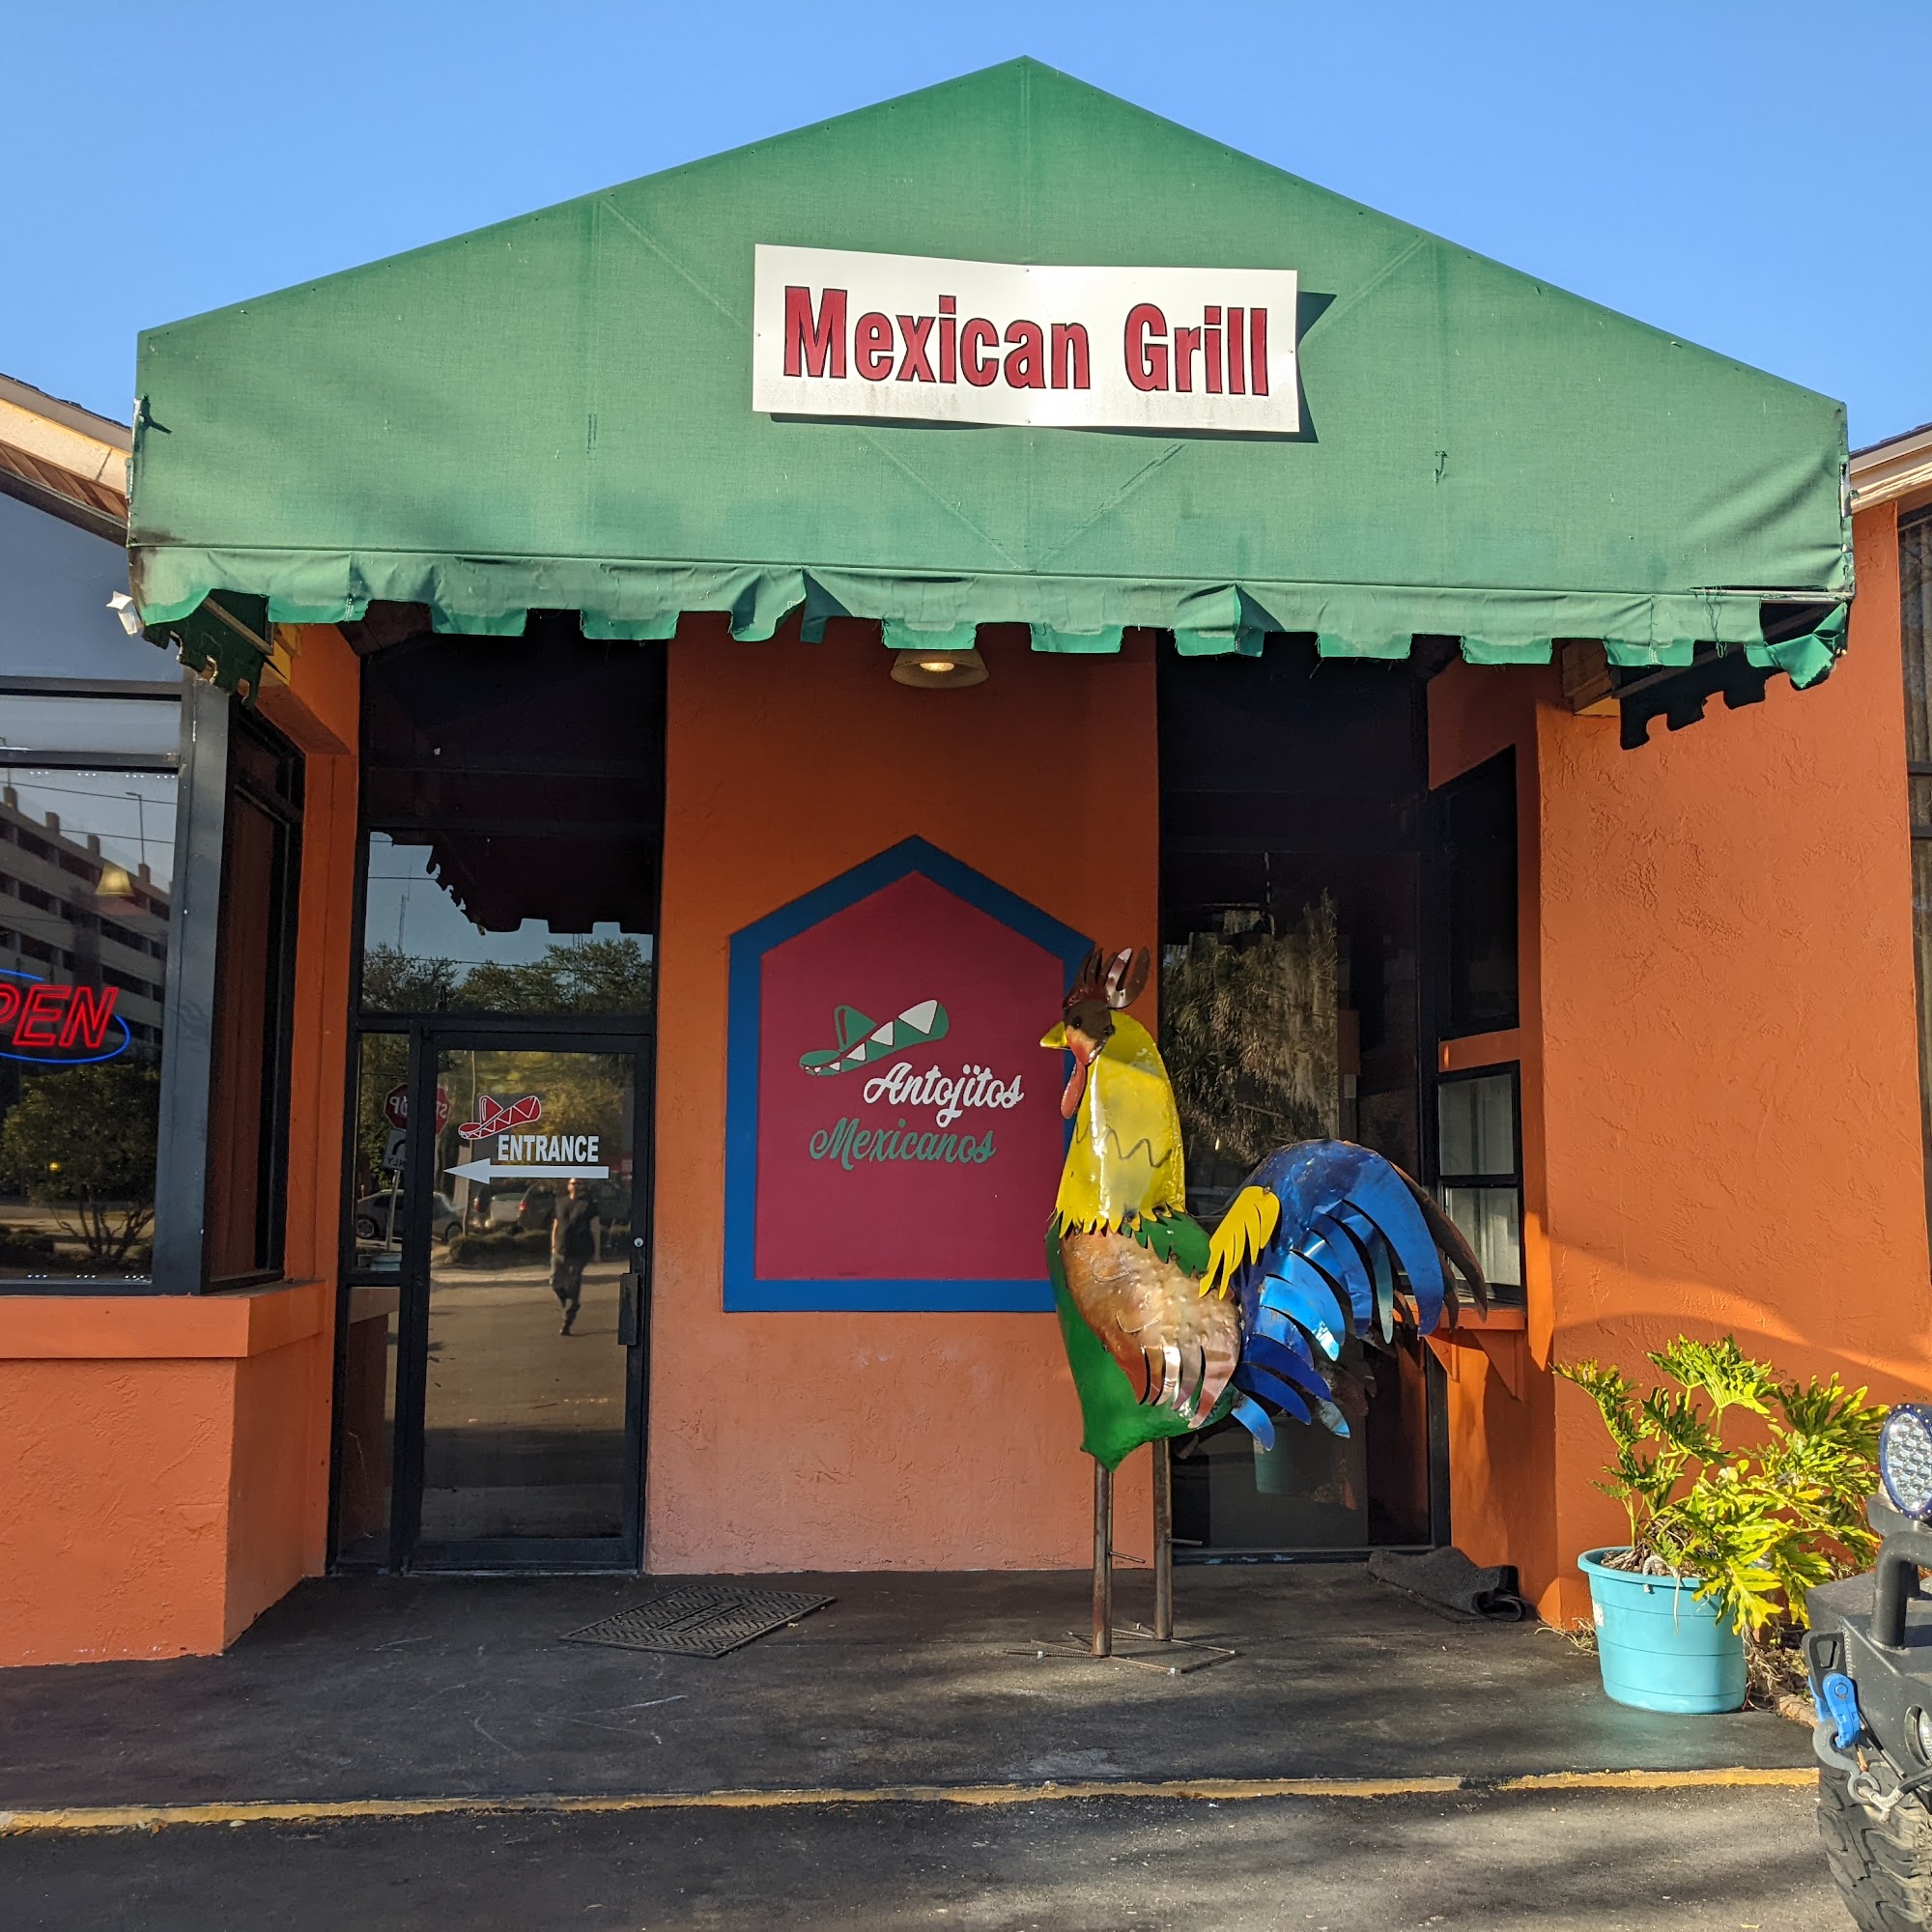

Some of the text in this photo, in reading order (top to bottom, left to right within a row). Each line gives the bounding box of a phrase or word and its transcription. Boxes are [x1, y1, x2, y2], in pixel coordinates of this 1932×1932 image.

[783, 285, 1269, 397] Mexican Grill
[863, 1063, 1025, 1127] Antojitos
[497, 1134, 599, 1163] ENTRANCE
[809, 1117, 997, 1171] Mexicanos
